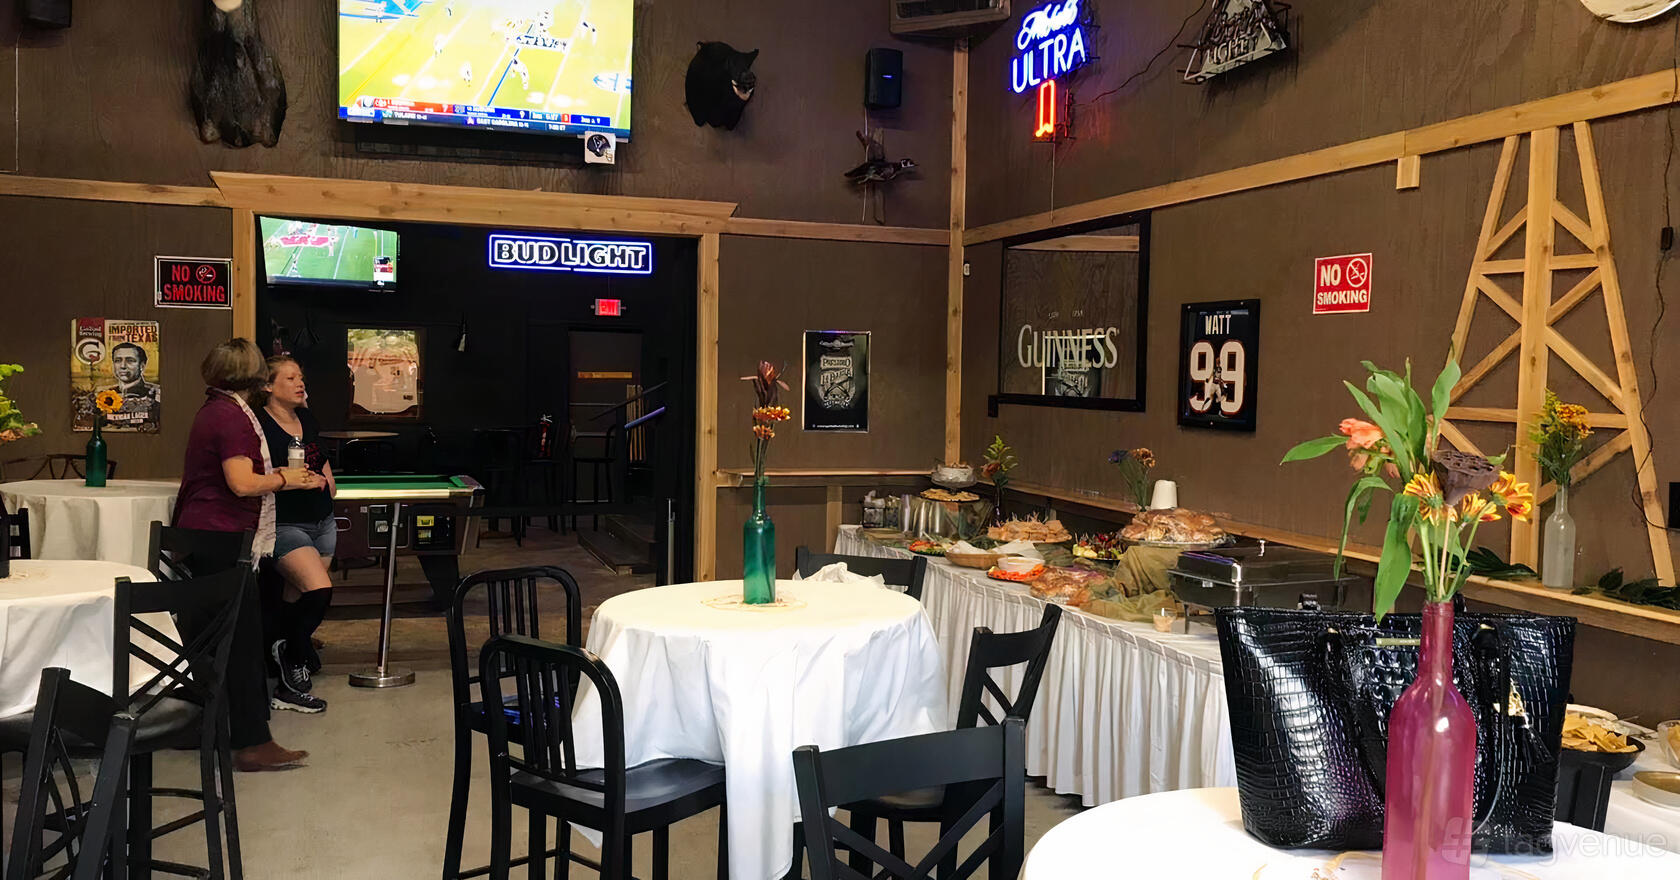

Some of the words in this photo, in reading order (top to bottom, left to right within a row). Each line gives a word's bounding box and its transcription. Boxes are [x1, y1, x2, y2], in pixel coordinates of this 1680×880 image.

[1012, 28, 1086, 93] ULTRA
[494, 240, 558, 264] BUD
[561, 243, 646, 268] LIGHT
[171, 264, 190, 282] NO
[1320, 263, 1341, 287] NO
[163, 284, 226, 302] SMOKING
[1316, 289, 1368, 305] SMOKING
[108, 325, 157, 335] IMPORTED
[1205, 314, 1231, 335] WATT
[126, 333, 158, 342] TEXAS
[1017, 324, 1118, 369] GUINNESS
[1189, 339, 1246, 414] 99
